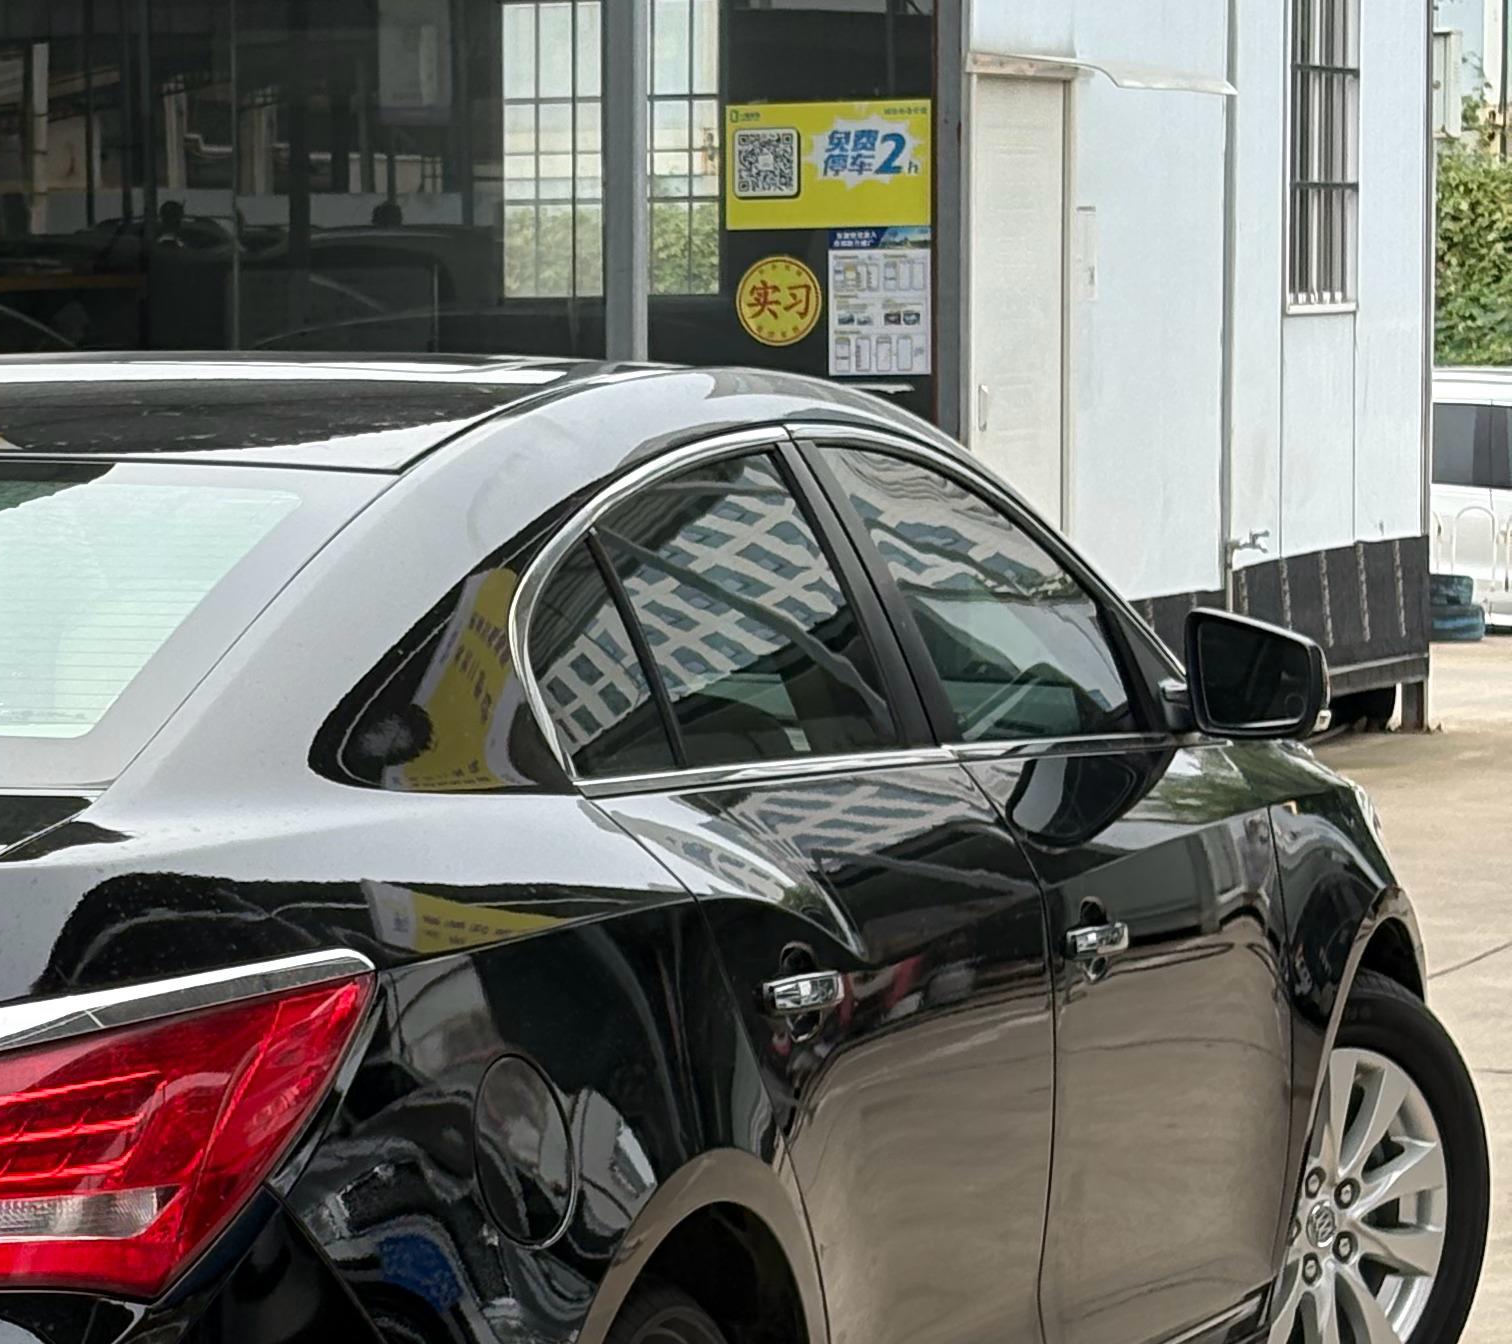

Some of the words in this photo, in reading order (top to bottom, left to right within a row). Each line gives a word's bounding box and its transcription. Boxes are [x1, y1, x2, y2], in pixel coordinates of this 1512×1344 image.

[824, 129, 879, 153] 免费
[823, 153, 874, 176] 停车
[746, 280, 812, 320] 实习
